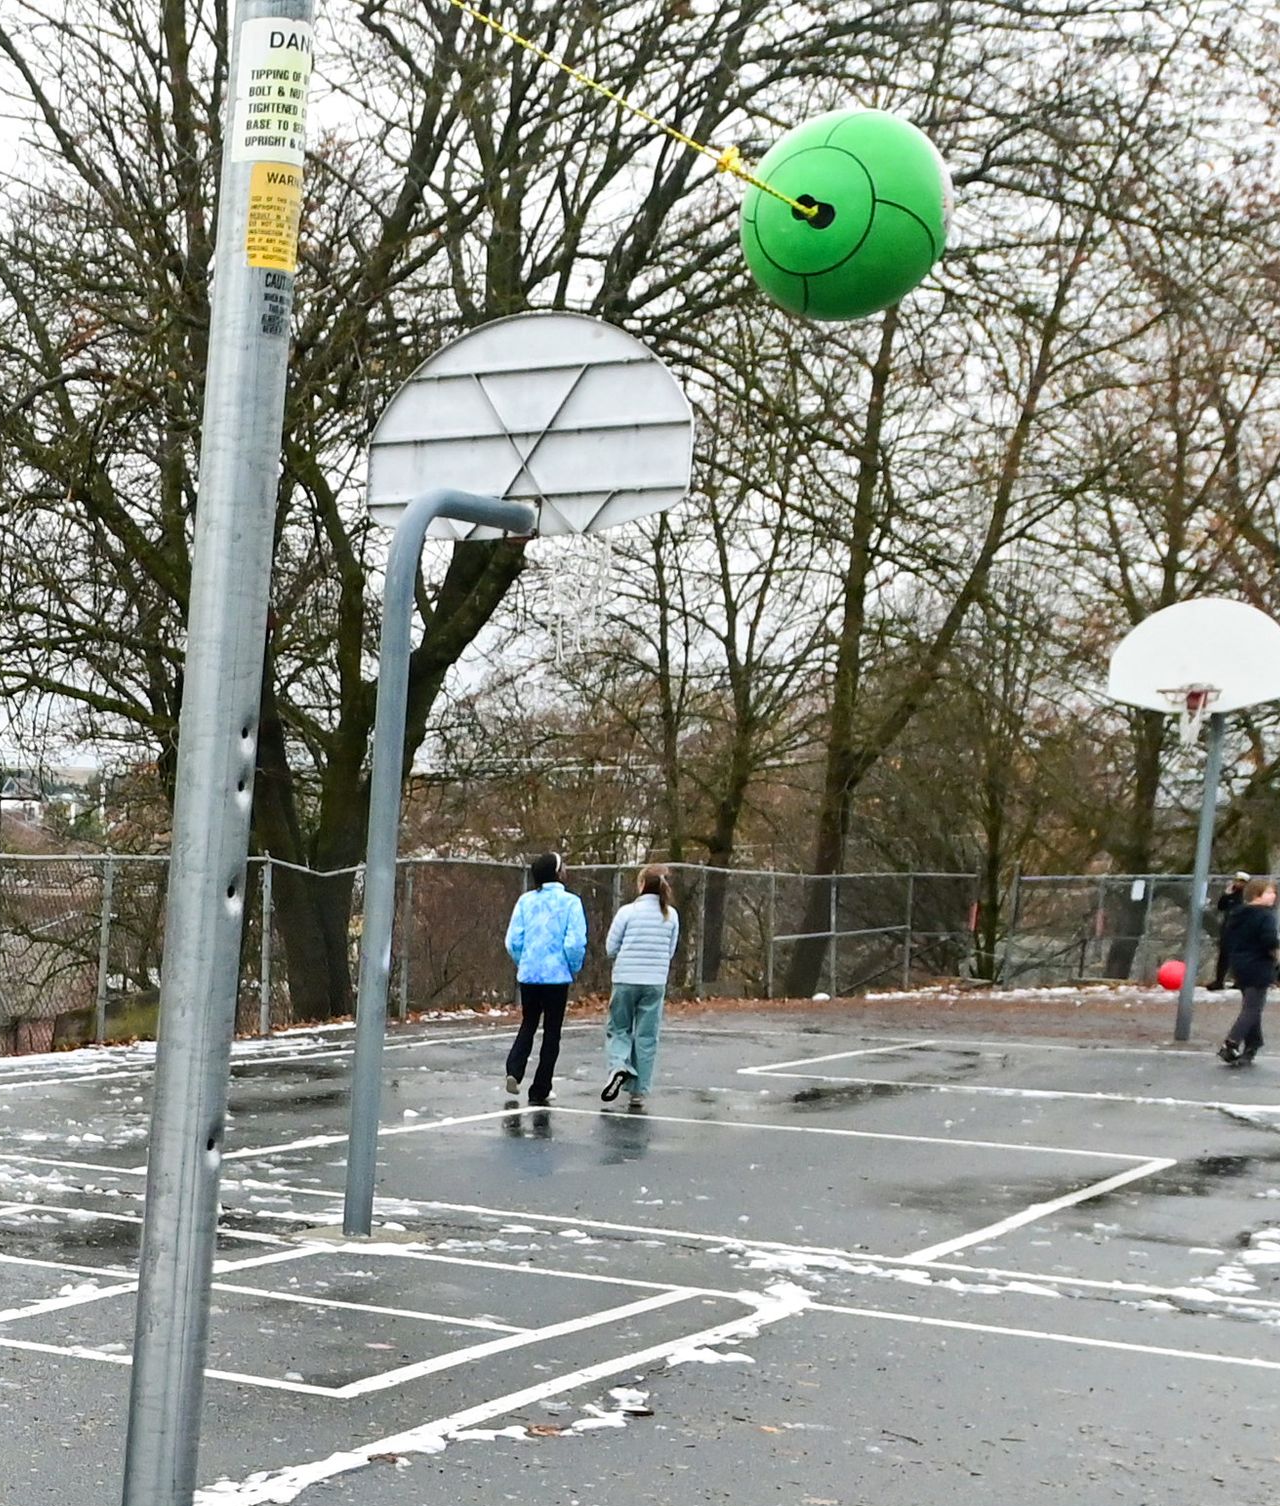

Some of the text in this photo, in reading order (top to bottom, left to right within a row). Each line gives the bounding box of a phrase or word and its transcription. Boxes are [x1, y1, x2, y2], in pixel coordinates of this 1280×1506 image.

[251, 69, 290, 81] TIPPING
[249, 86, 272, 97] BOLT
[248, 102, 298, 116] TIGHTENED
[246, 119, 271, 131] BASE
[277, 119, 289, 131] TO
[244, 135, 287, 147] UPRIGHT
